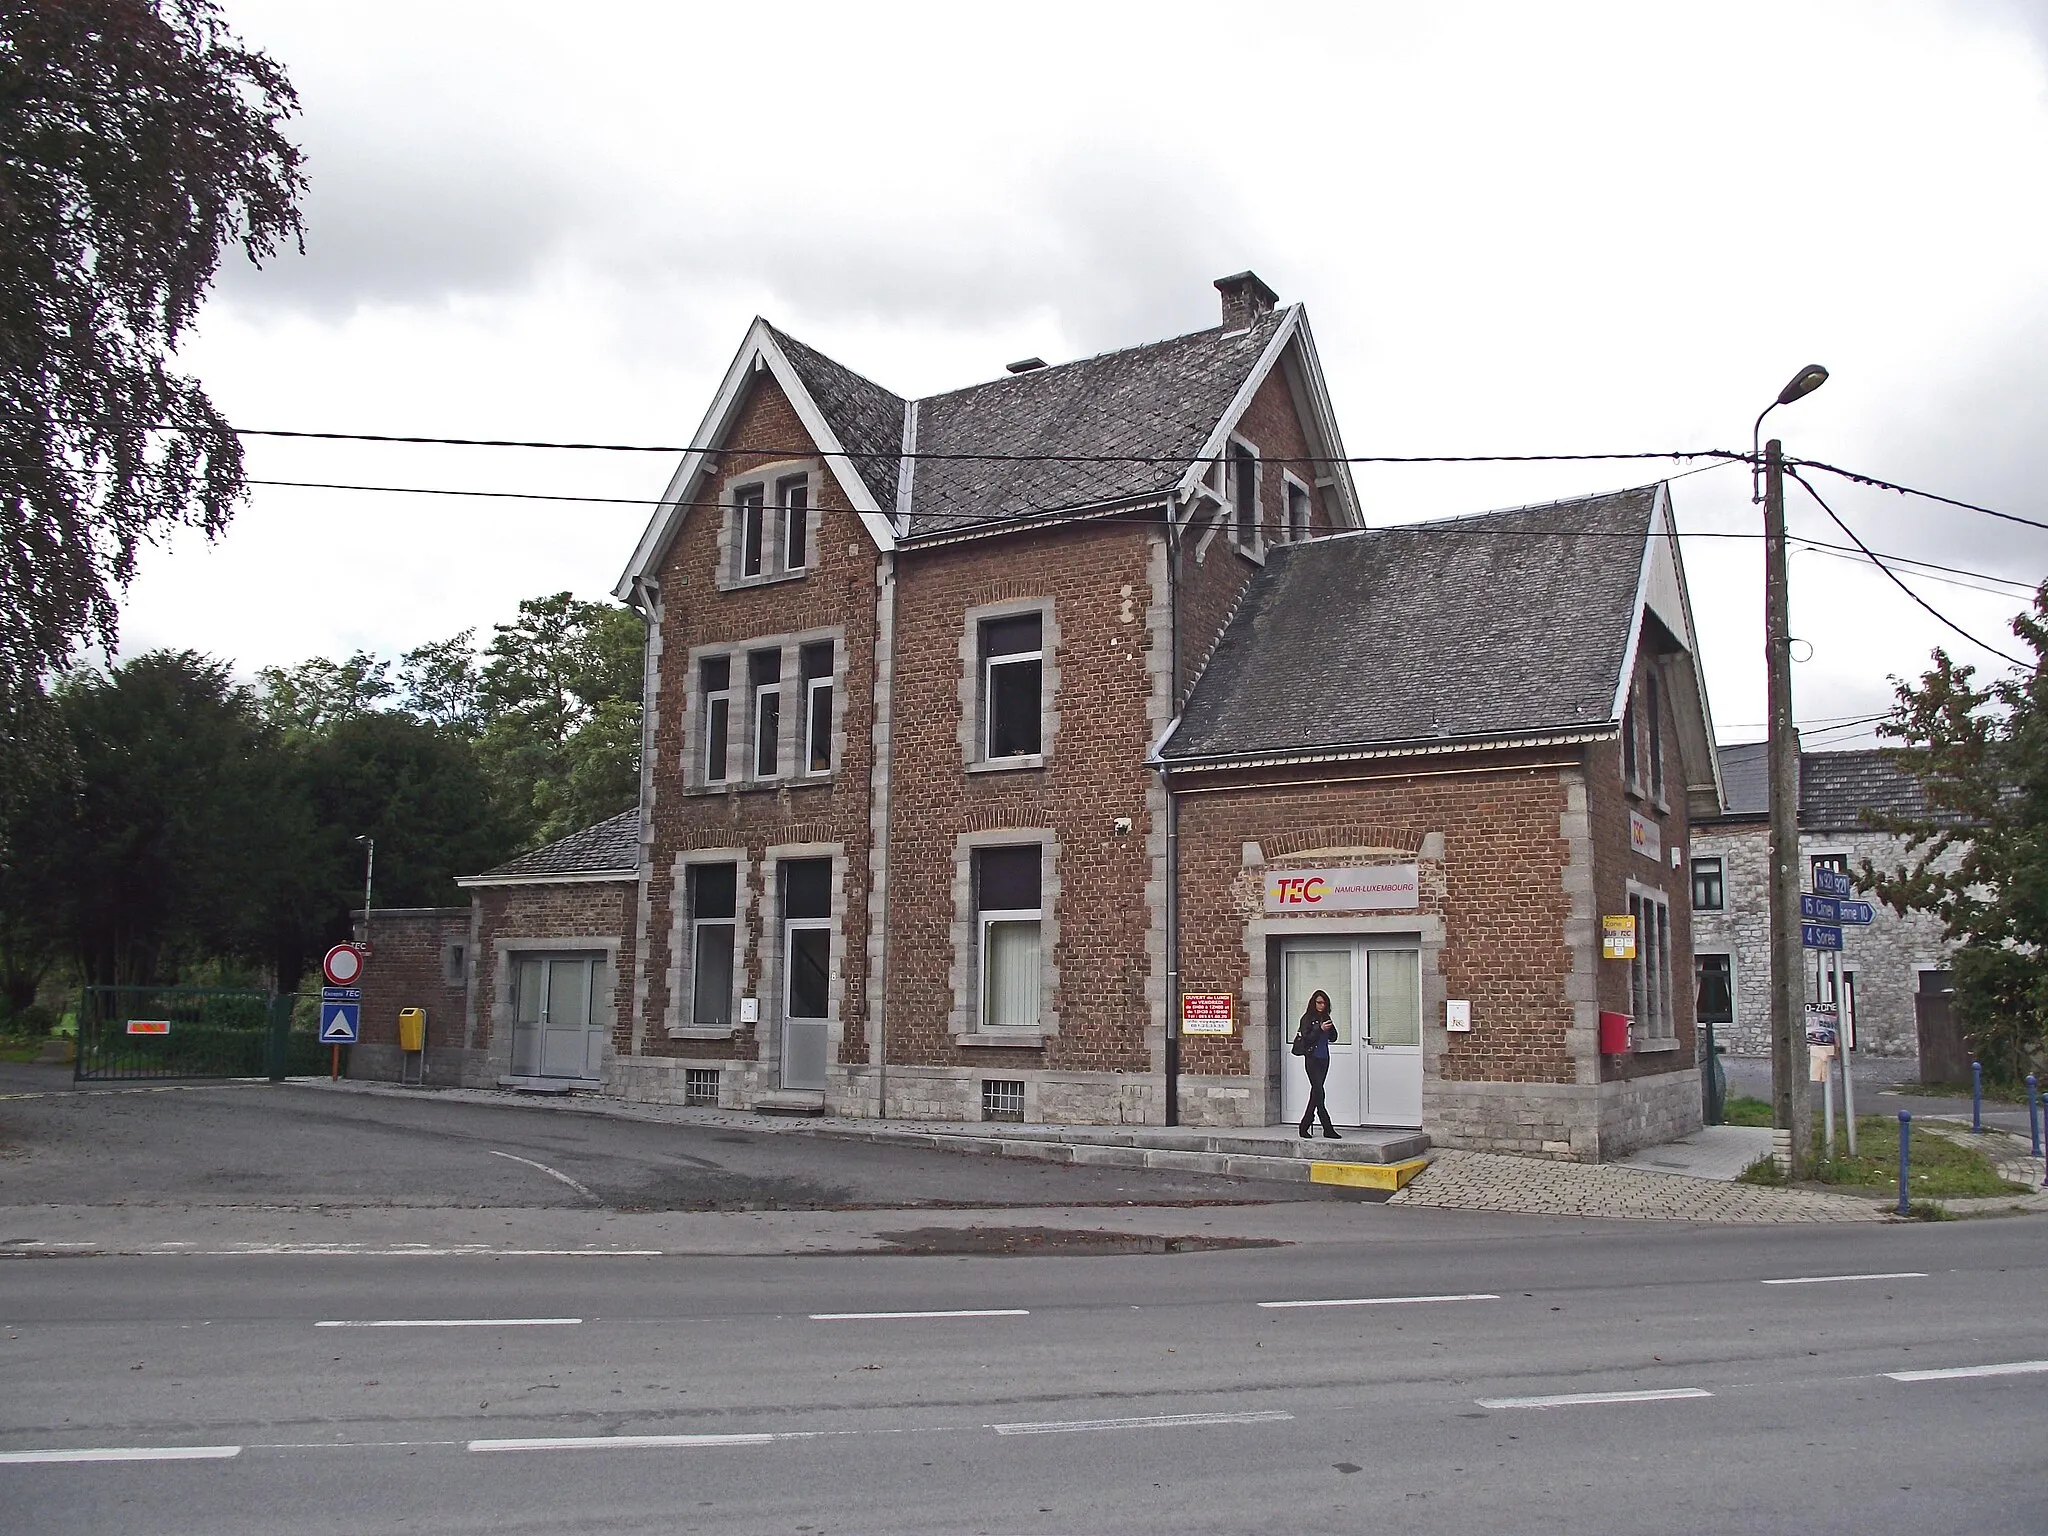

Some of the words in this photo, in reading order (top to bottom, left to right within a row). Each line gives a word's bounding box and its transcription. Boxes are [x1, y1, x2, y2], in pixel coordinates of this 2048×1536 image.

[1278, 877, 1325, 903] TEC
[1334, 883, 1414, 893] NAMUR-LUXEMBOURG
[1805, 898, 1813, 914] 15
[1816, 900, 1834, 920] Ciney
[1860, 905, 1868, 920] 10
[1807, 927, 1813, 943] 4
[1816, 928, 1836, 945] Sorée
[350, 942, 367, 950] TEC
